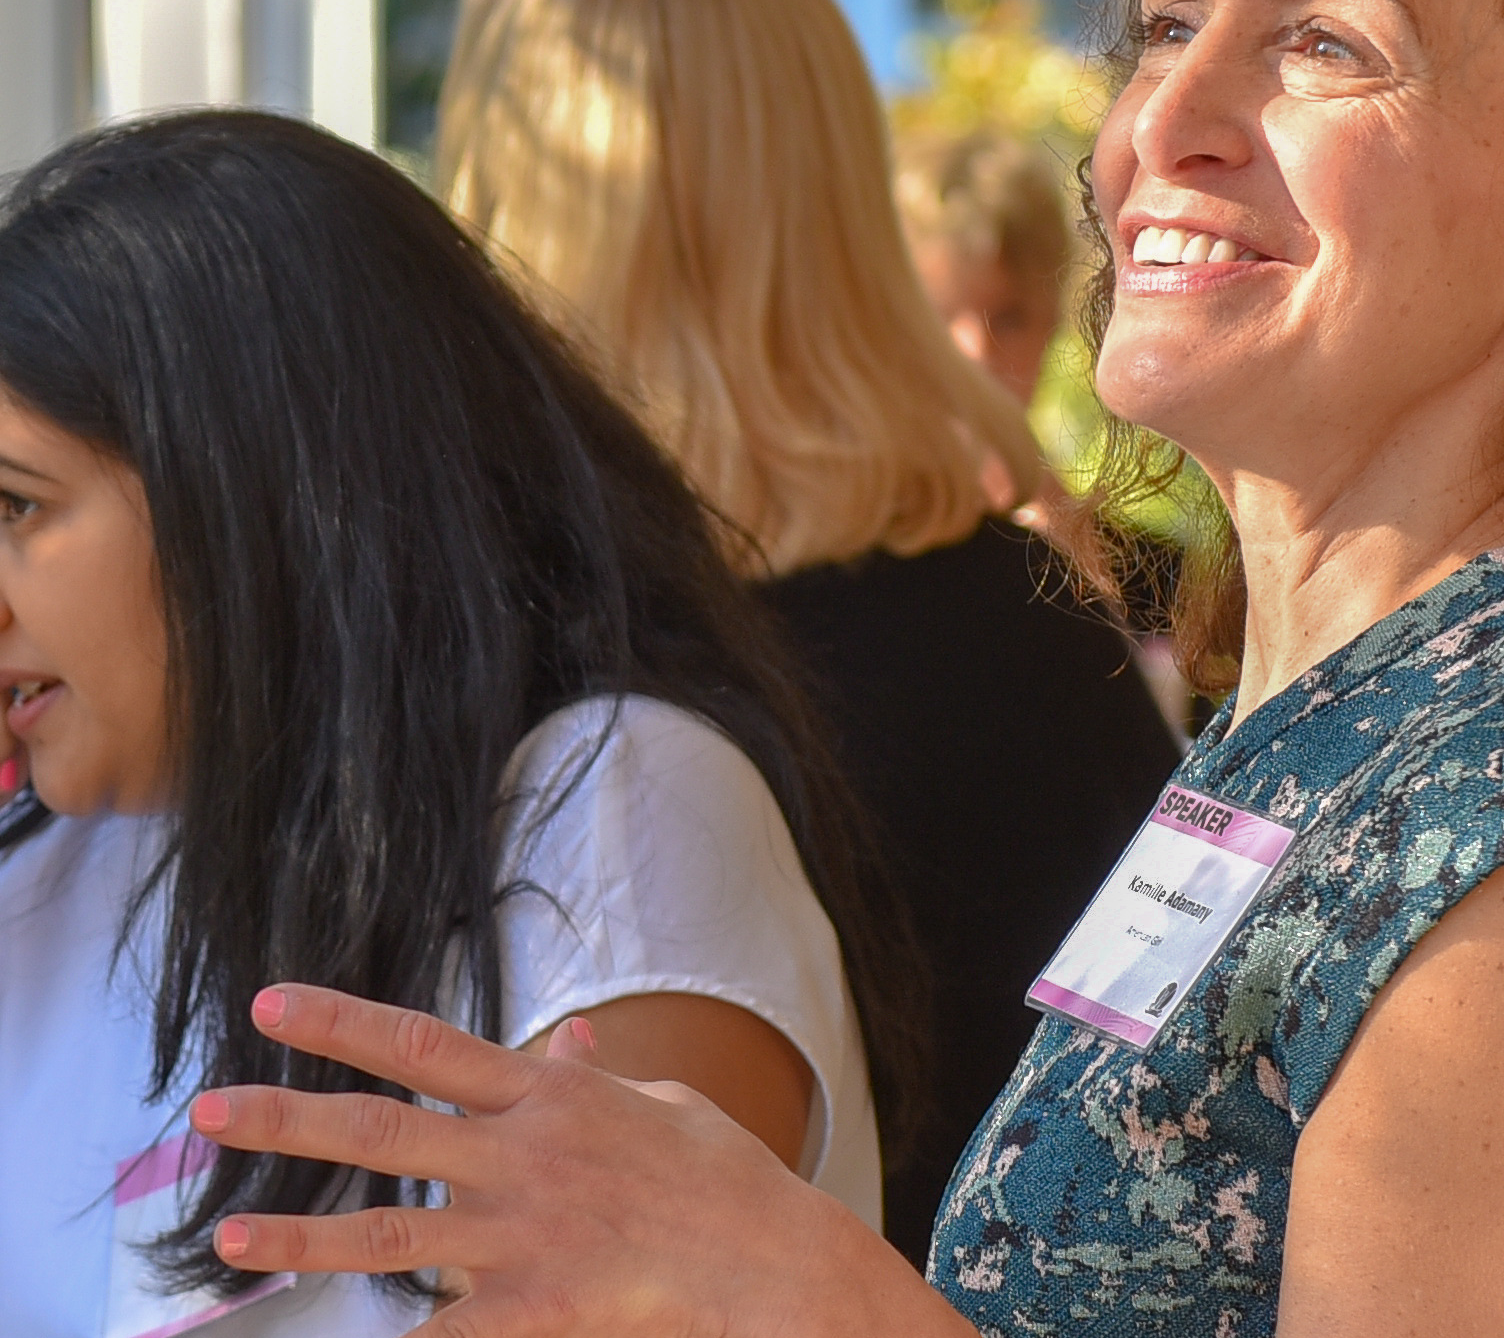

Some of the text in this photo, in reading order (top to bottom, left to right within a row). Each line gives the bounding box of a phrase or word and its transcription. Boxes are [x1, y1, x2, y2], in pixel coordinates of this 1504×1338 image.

[1159, 791, 1234, 837] SPEAKER
[1127, 875, 1214, 925] Kamille Adamany
